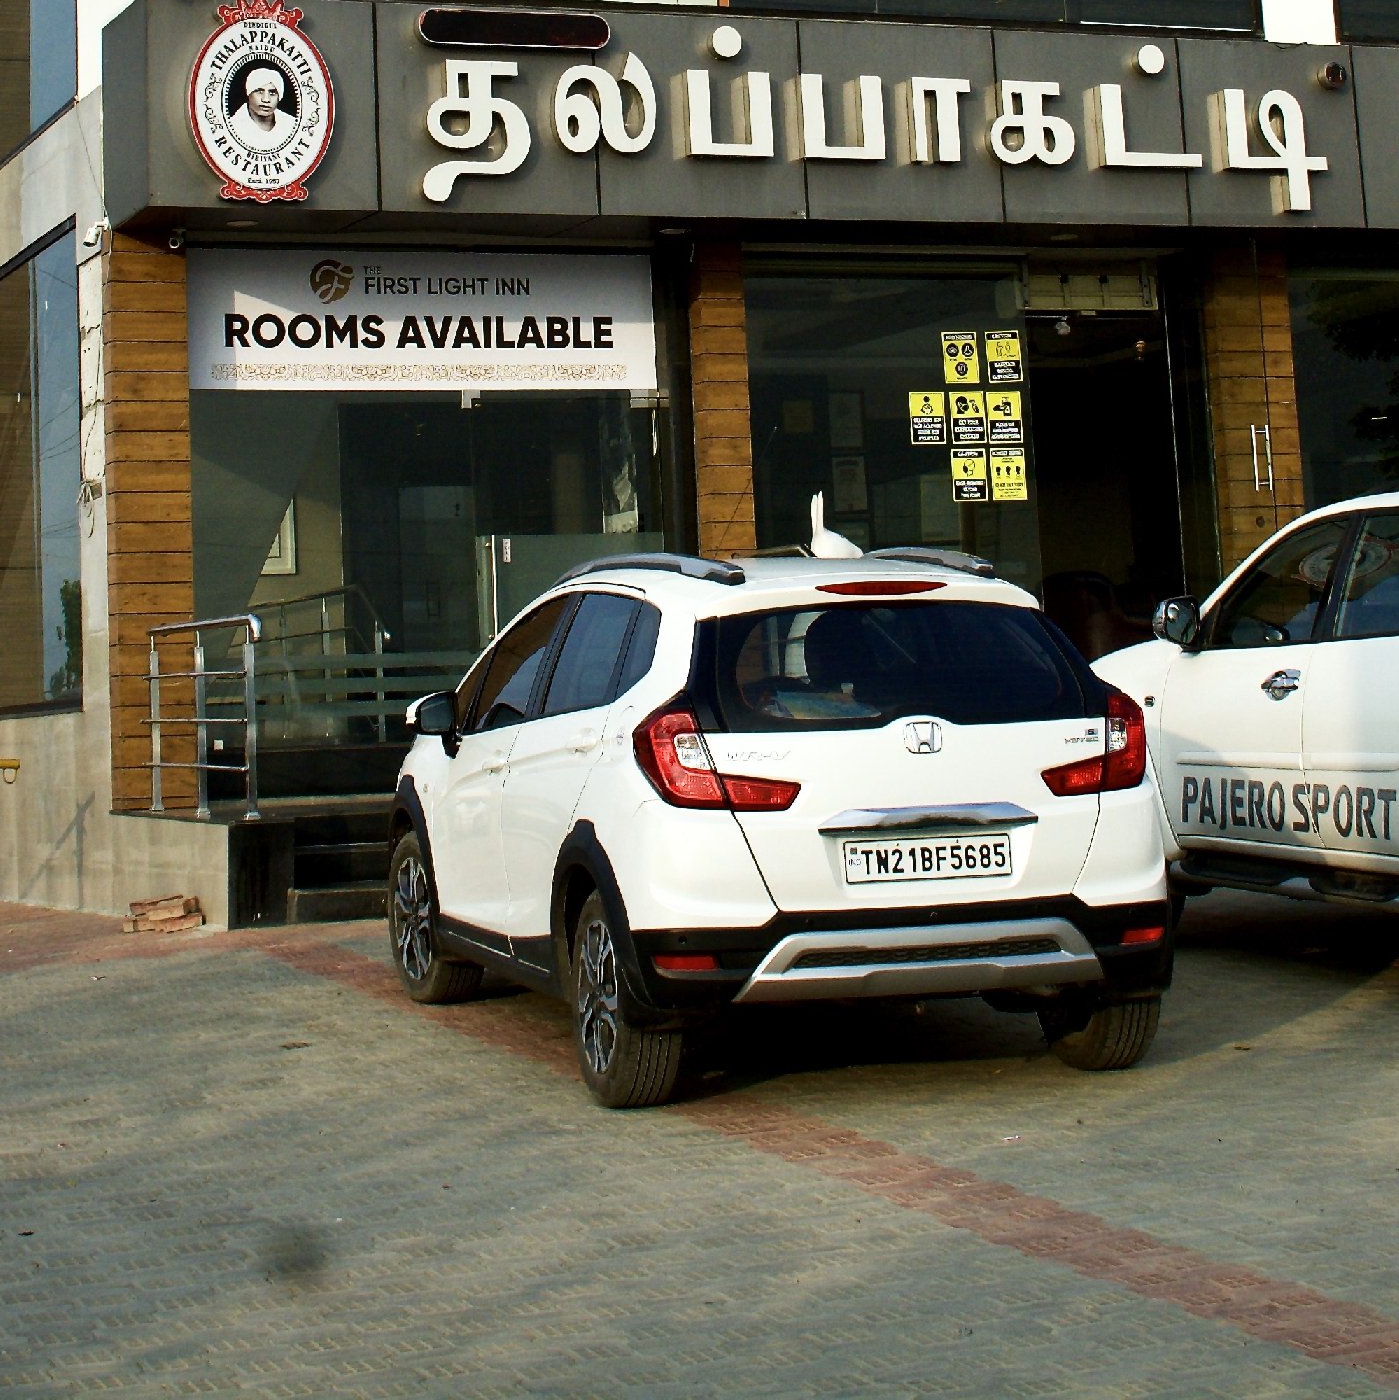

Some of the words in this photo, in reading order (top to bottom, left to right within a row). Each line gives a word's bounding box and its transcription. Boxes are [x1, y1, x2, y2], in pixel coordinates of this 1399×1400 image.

[210, 30, 312, 75] THALAPPAKATTI
[422, 25, 1328, 212] தலப்பாகட்டி
[214, 135, 311, 176] RESTAURANT
[363, 265, 381, 275] THE
[364, 277, 421, 295] FIRST
[427, 277, 489, 295] LIGHT
[495, 277, 530, 296] INN
[224, 313, 386, 349] ROOMS
[396, 314, 614, 350] AVAILABLE
[1181, 776, 1285, 832] PAJERO
[1292, 783, 1397, 840] SPORT
[860, 842, 1007, 876] TN21BF5685
